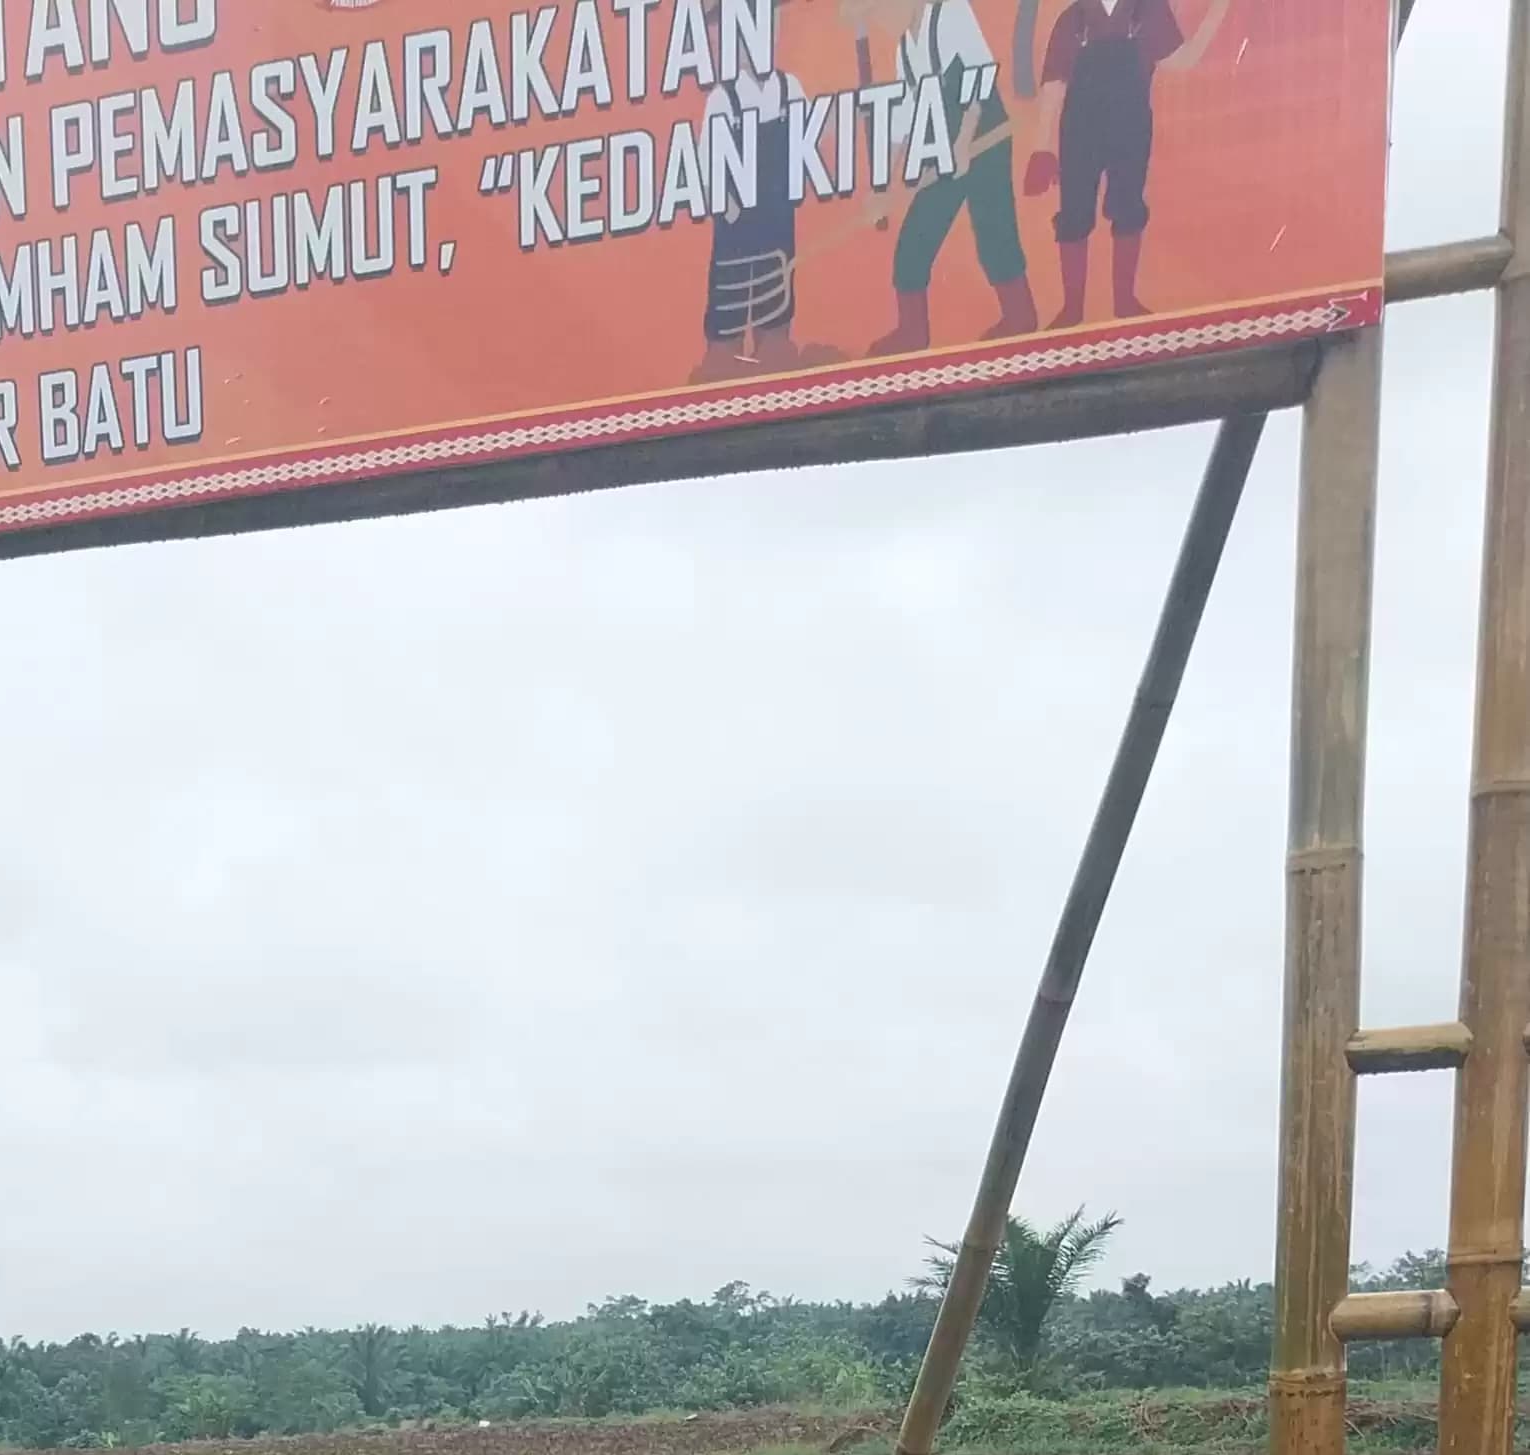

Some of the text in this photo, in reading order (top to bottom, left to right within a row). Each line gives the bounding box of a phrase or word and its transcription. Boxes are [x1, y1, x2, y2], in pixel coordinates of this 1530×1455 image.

[50, 0, 775, 210] PEMASYARAKATAN
[198, 166, 457, 303] SUMUT,
[39, 346, 203, 465] BATU
